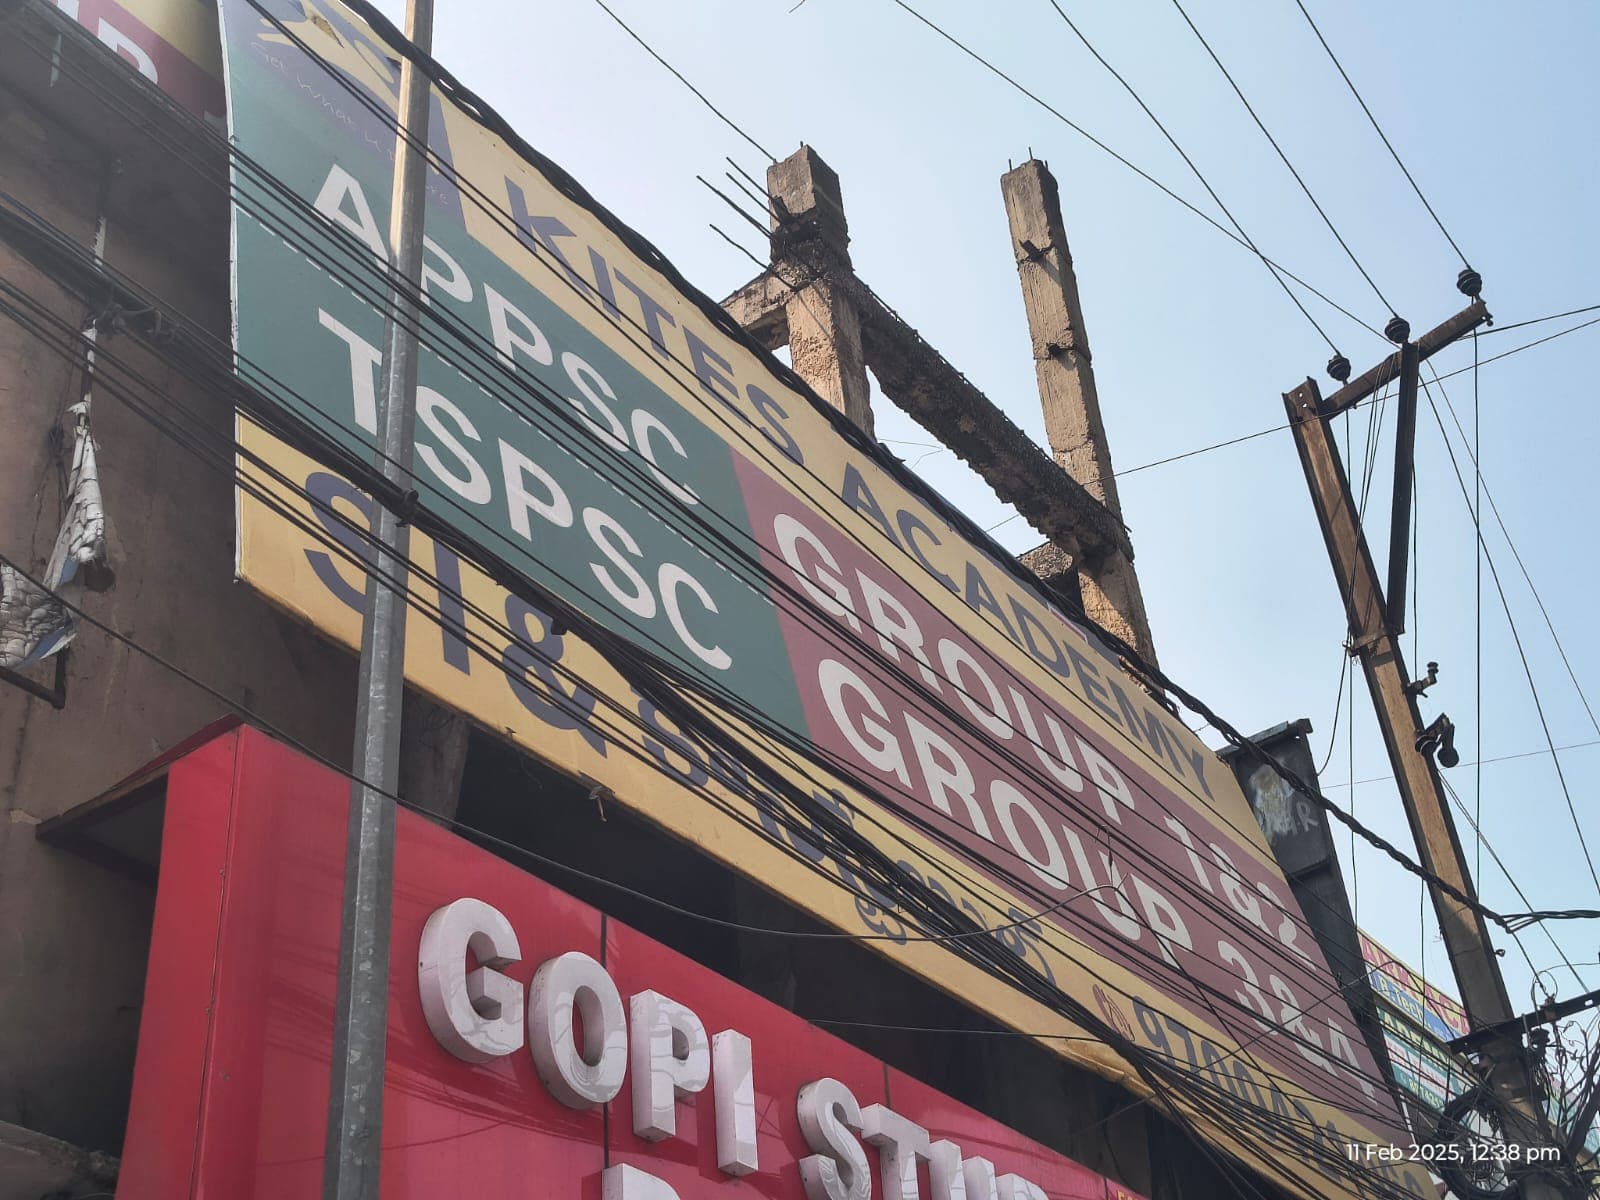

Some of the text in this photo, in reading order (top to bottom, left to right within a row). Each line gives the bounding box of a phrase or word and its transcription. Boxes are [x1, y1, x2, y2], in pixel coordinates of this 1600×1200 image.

[314, 164, 699, 506] APPSC
[773, 513, 1137, 826] GROUP
[318, 307, 732, 671] TSPSC
[818, 658, 1194, 970] GROUP
[504, 174, 1216, 801] KITES ACADEMY
[417, 897, 1050, 1200] GOPI ST
